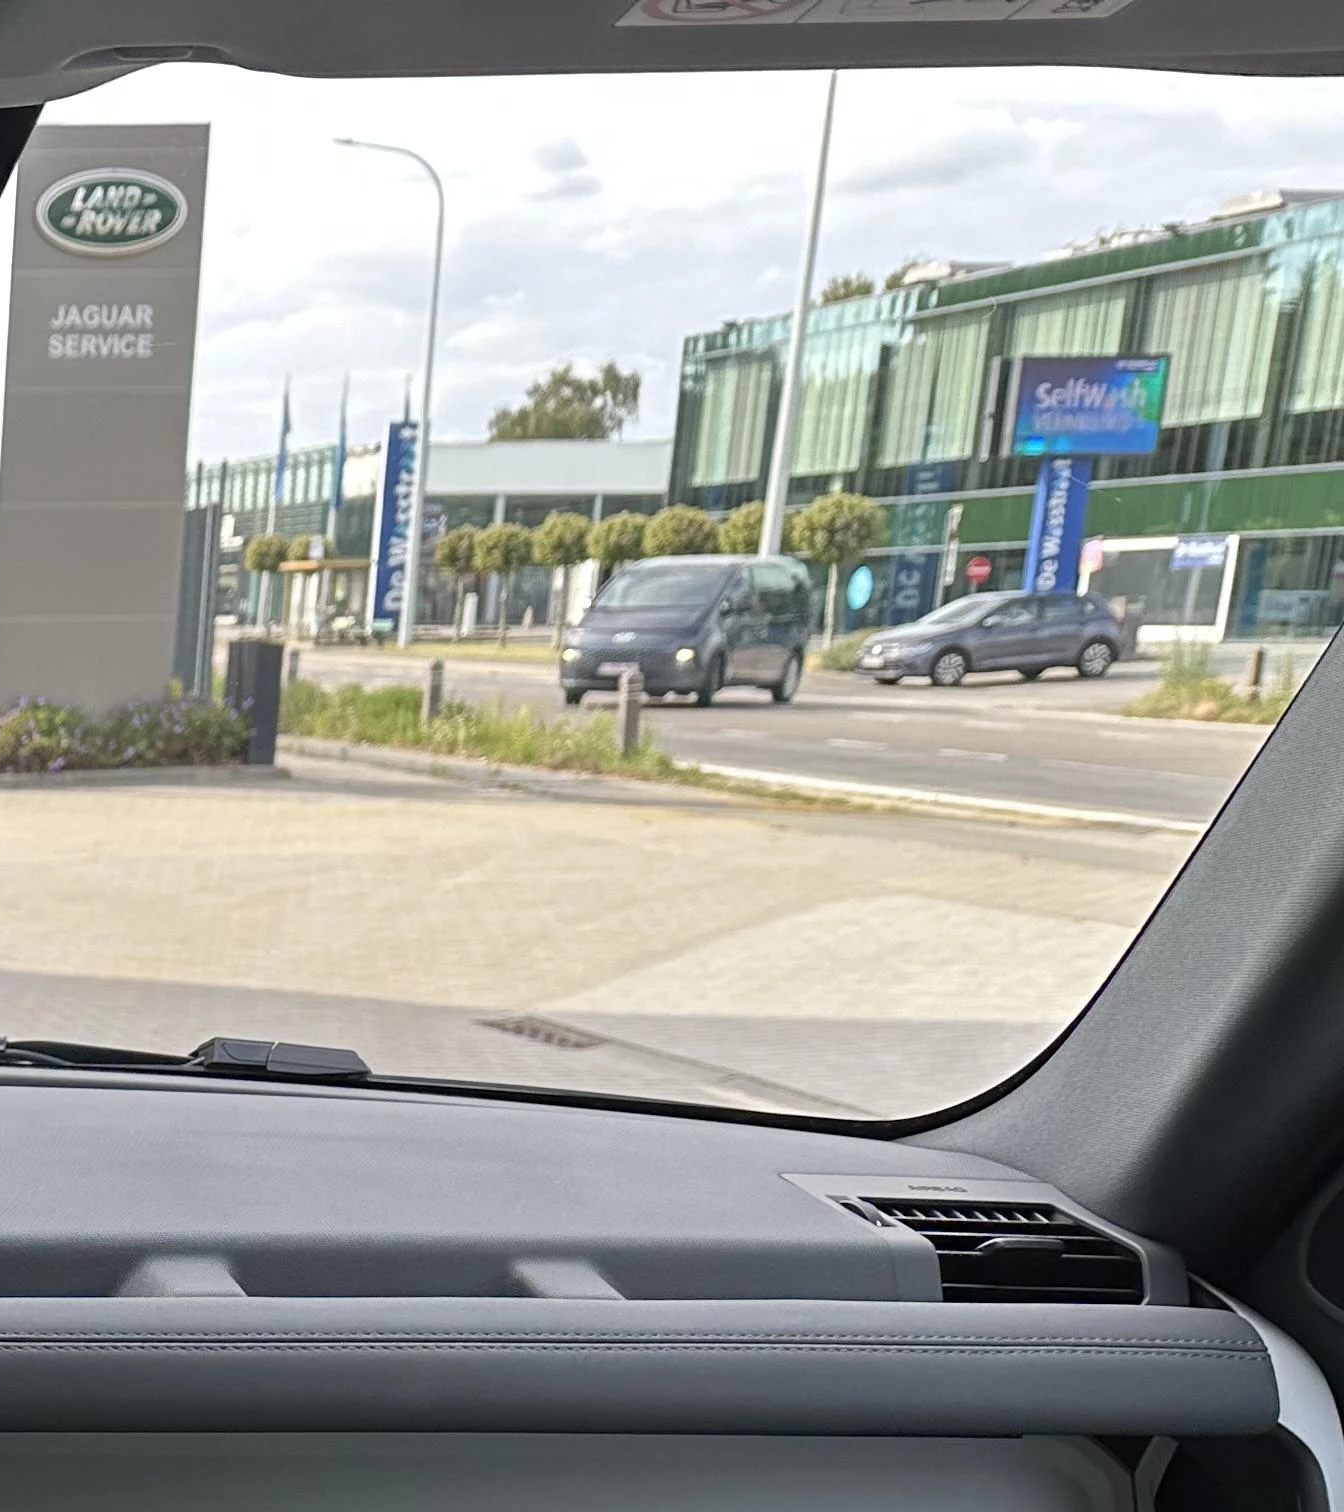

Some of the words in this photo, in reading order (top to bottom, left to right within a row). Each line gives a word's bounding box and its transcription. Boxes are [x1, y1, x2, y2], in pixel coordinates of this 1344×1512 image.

[70, 185, 142, 211] LAND
[76, 208, 162, 235] ROVER
[51, 304, 154, 328] JAGUAR
[48, 333, 153, 359] SERVICE
